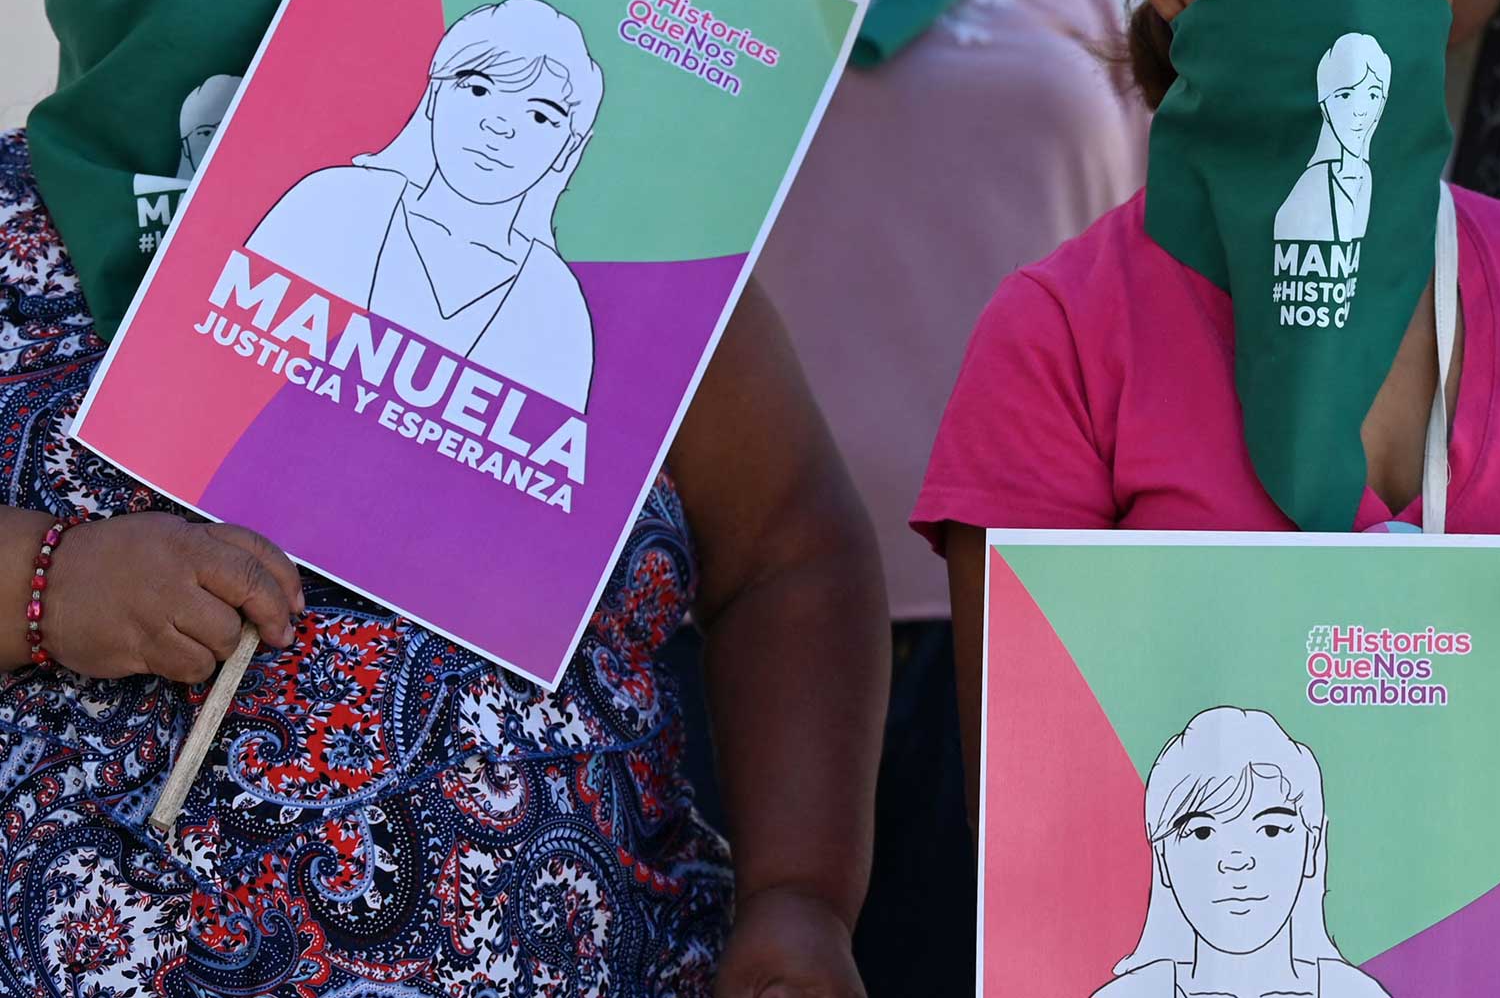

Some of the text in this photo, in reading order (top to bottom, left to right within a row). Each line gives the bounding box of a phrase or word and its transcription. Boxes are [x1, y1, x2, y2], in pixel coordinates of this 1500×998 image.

[627, 0, 737, 68] QueNos
[618, 18, 742, 96] Cambian
[1272, 280, 1347, 304] #HISTO
[1280, 305, 1330, 328] NOS
[208, 249, 588, 485] MANUELA
[193, 311, 574, 513] JUSTICIA Y ESPERANZA
[1306, 625, 1472, 654] #Historias
[1307, 653, 1432, 679] QueNos
[1307, 678, 1448, 705] Cambian
